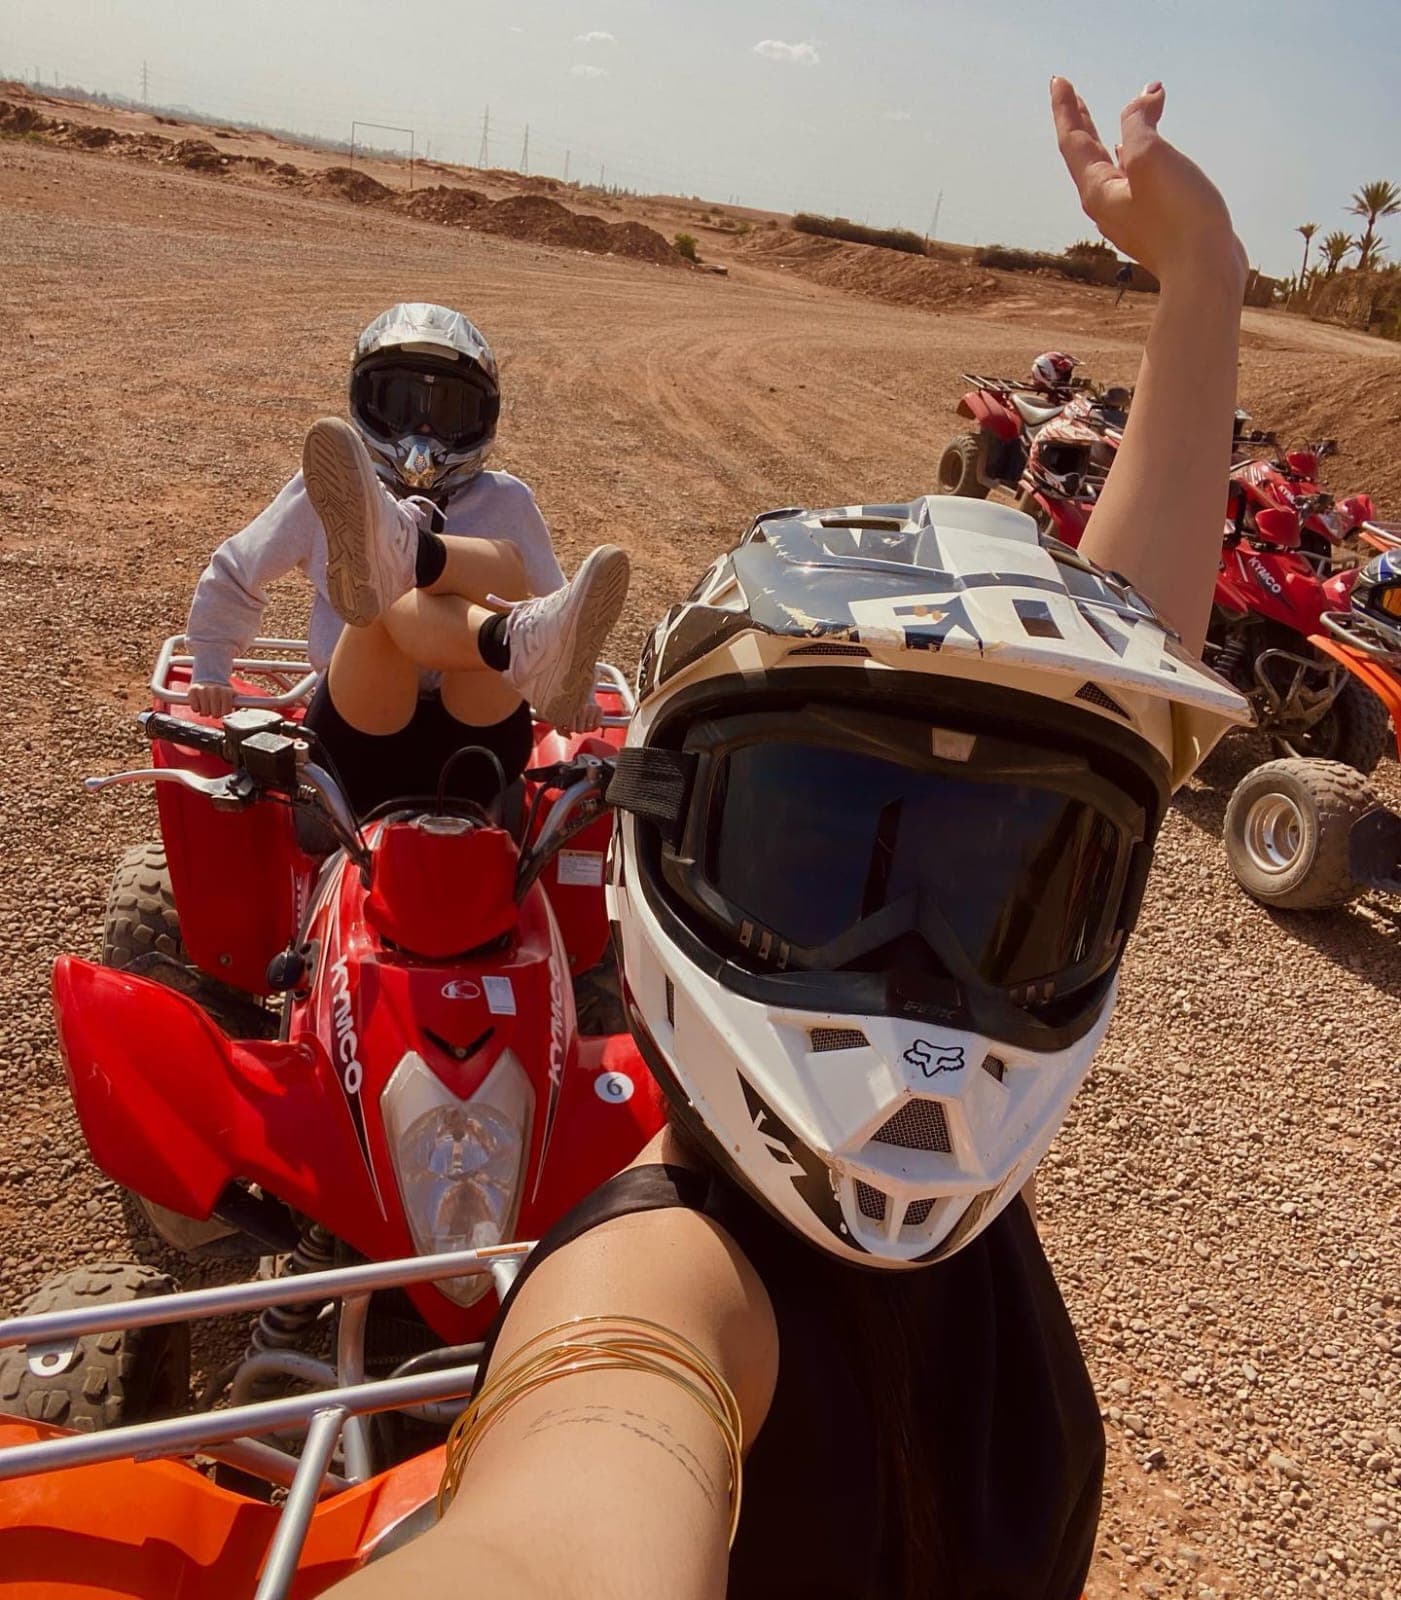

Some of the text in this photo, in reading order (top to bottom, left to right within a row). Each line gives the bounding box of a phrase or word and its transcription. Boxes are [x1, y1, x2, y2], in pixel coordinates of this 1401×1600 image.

[1247, 556, 1283, 594] KYMCO
[330, 954, 363, 1094] KYMCO
[606, 1077, 623, 1096] 6
